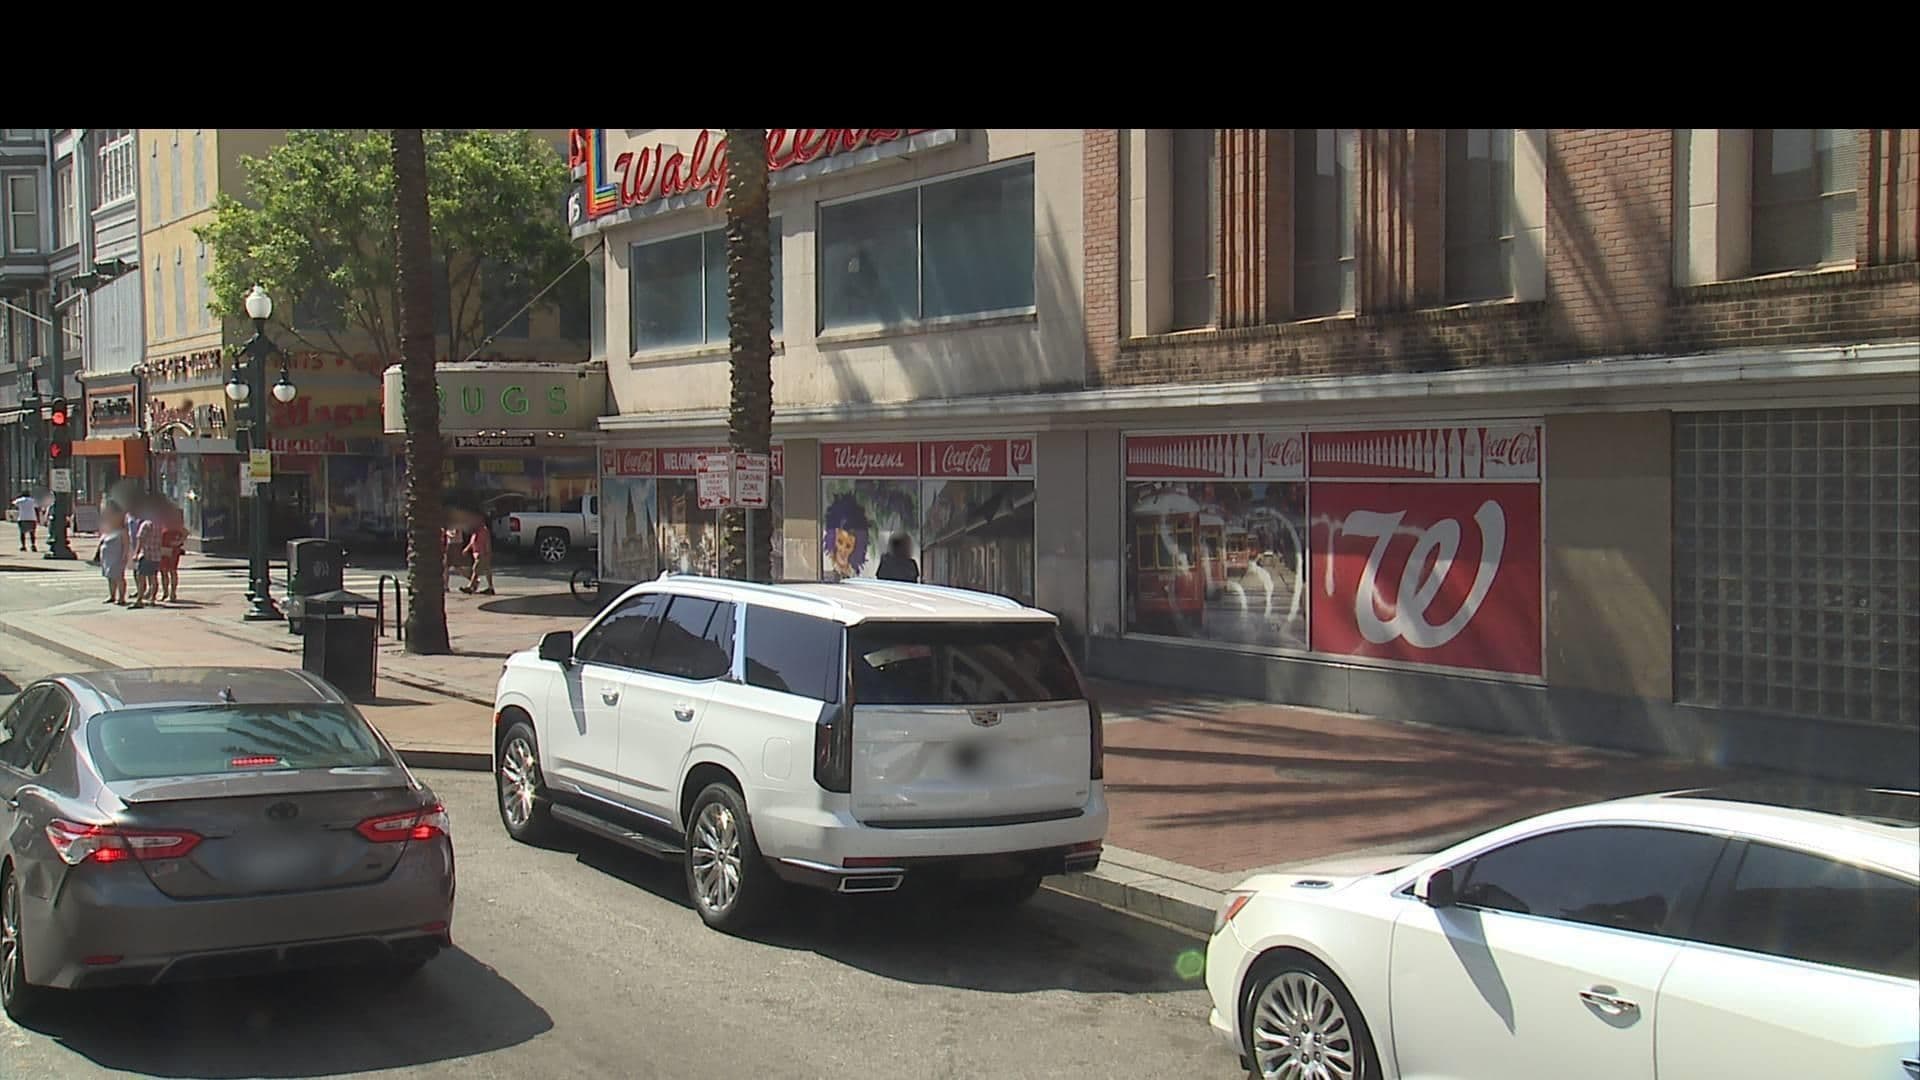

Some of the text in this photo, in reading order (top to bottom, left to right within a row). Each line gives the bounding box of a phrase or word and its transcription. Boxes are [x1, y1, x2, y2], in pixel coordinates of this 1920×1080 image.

[615, 129, 898, 208] Walgeen
[437, 384, 568, 416] UGS
[664, 452, 699, 470] WELCOM
[834, 446, 904, 475] Walgreens
[1013, 442, 1030, 461] W
[1341, 499, 1507, 649] W
